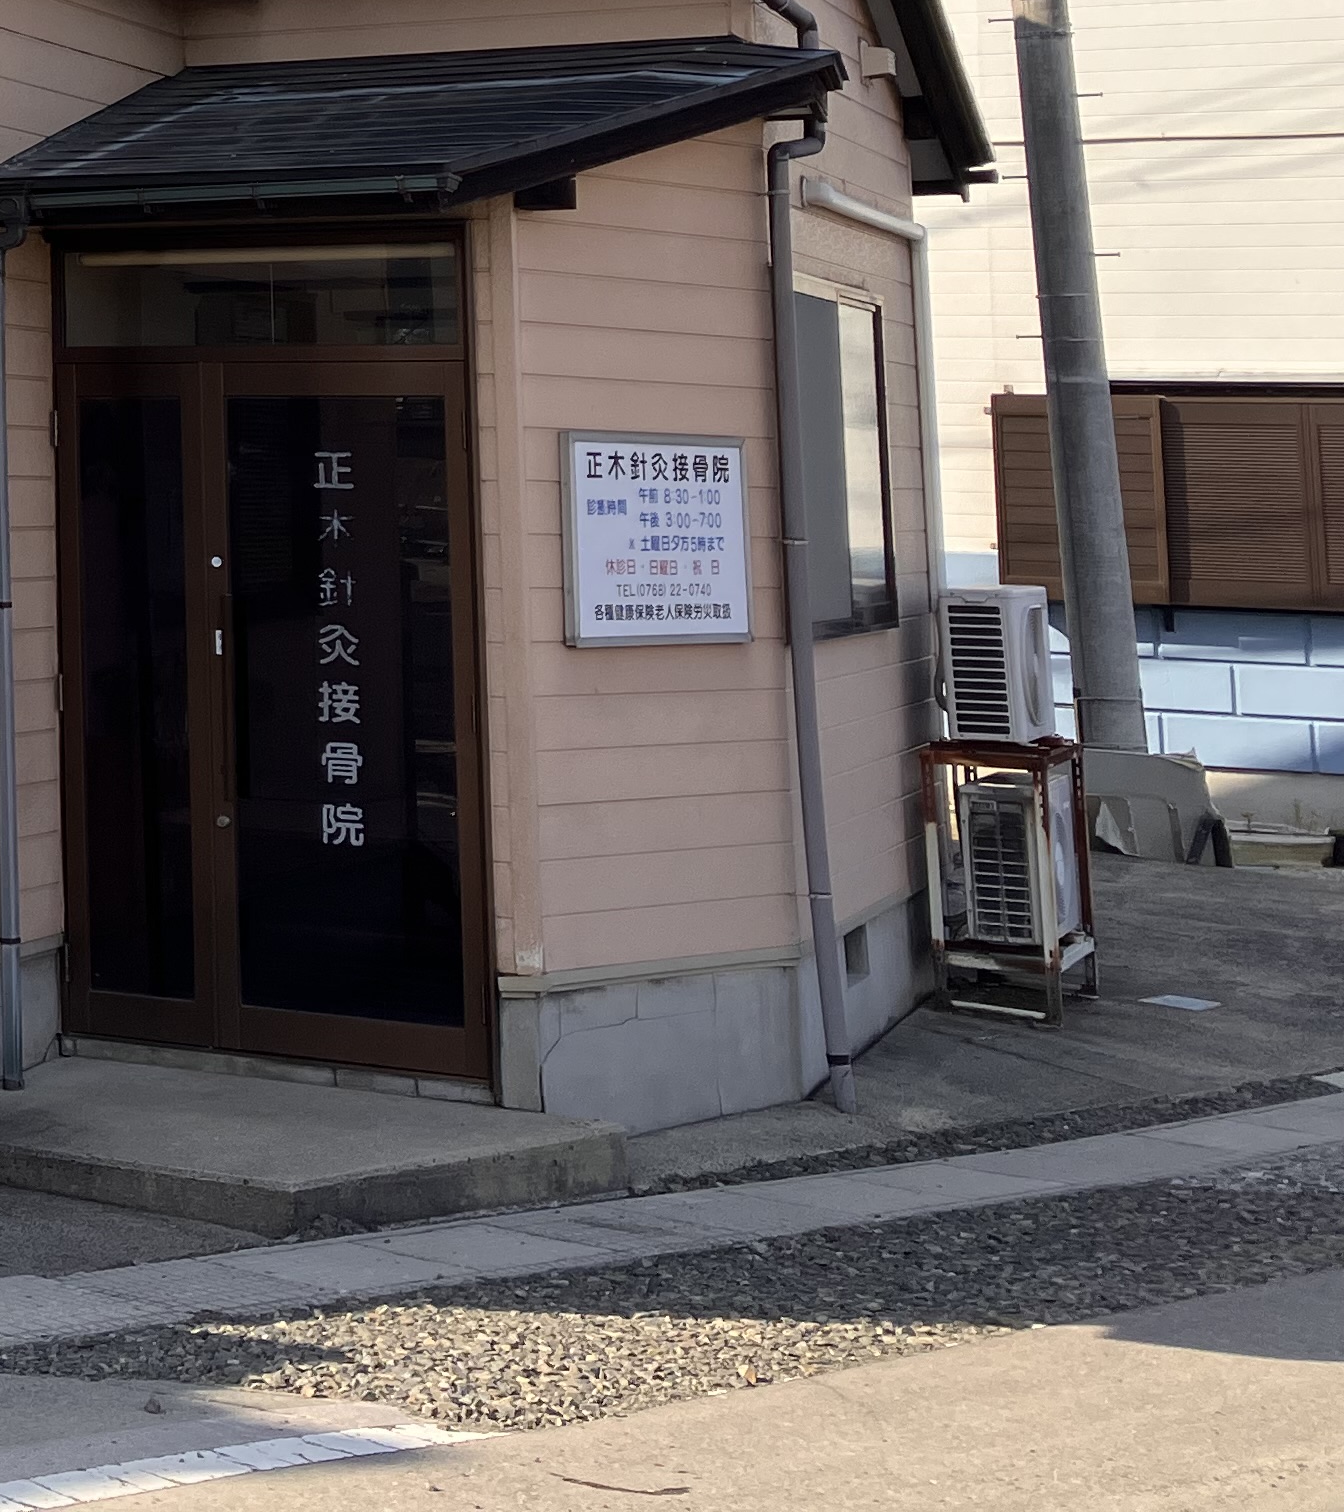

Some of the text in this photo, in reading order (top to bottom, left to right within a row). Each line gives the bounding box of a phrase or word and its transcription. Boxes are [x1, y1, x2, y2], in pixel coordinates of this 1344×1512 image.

[586, 450, 730, 483] 正木針灸接骨院
[313, 451, 365, 847] 正木針灸接骨院
